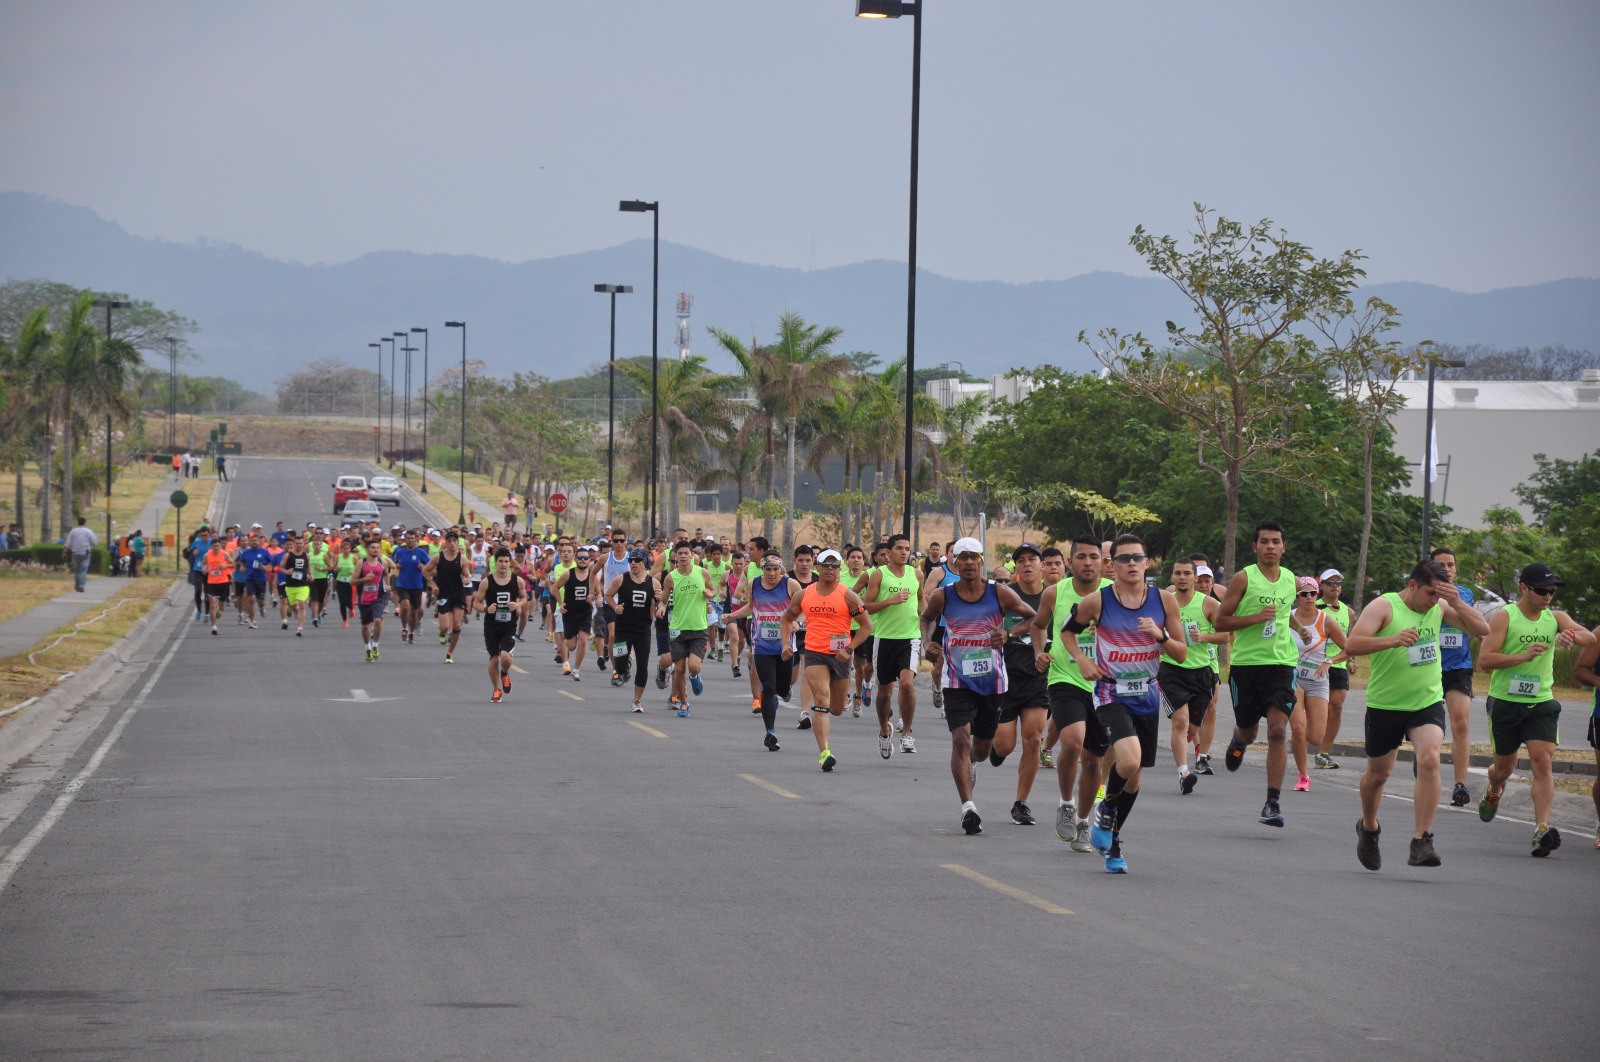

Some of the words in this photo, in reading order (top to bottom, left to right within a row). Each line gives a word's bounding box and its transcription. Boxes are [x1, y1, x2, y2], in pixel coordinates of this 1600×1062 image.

[549, 499, 566, 507] ALTO
[1259, 596, 1286, 604] COYOL
[1444, 635, 1457, 645] 373
[1519, 635, 1551, 643] COYOL
[1419, 646, 1437, 660] 255
[972, 660, 989, 672] 253
[1300, 669, 1309, 677] 67
[1518, 682, 1535, 694] 522
